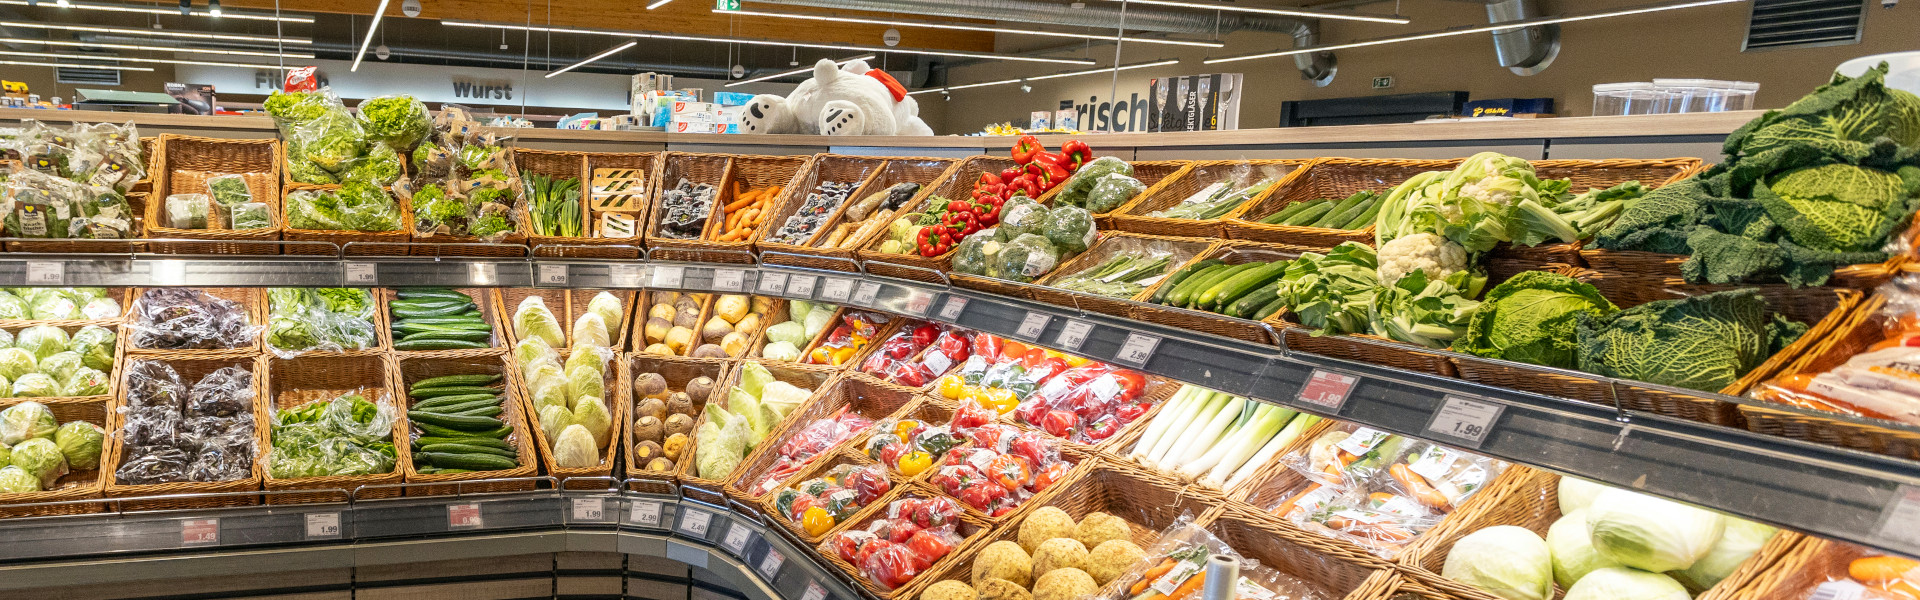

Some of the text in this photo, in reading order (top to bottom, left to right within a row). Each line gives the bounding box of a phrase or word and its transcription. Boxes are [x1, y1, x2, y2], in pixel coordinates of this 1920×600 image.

[453, 82, 513, 100] Wurst
[1211, 115, 1217, 126] 6
[1130, 350, 1148, 361] 2.99
[1318, 391, 1342, 405] 1.99
[1453, 421, 1483, 437] 1.99
[585, 510, 601, 518] 1.99
[641, 513, 657, 521] 2.99
[320, 525, 338, 533] 1.99
[691, 522, 705, 531] 2.49
[197, 532, 216, 540] 1.49
